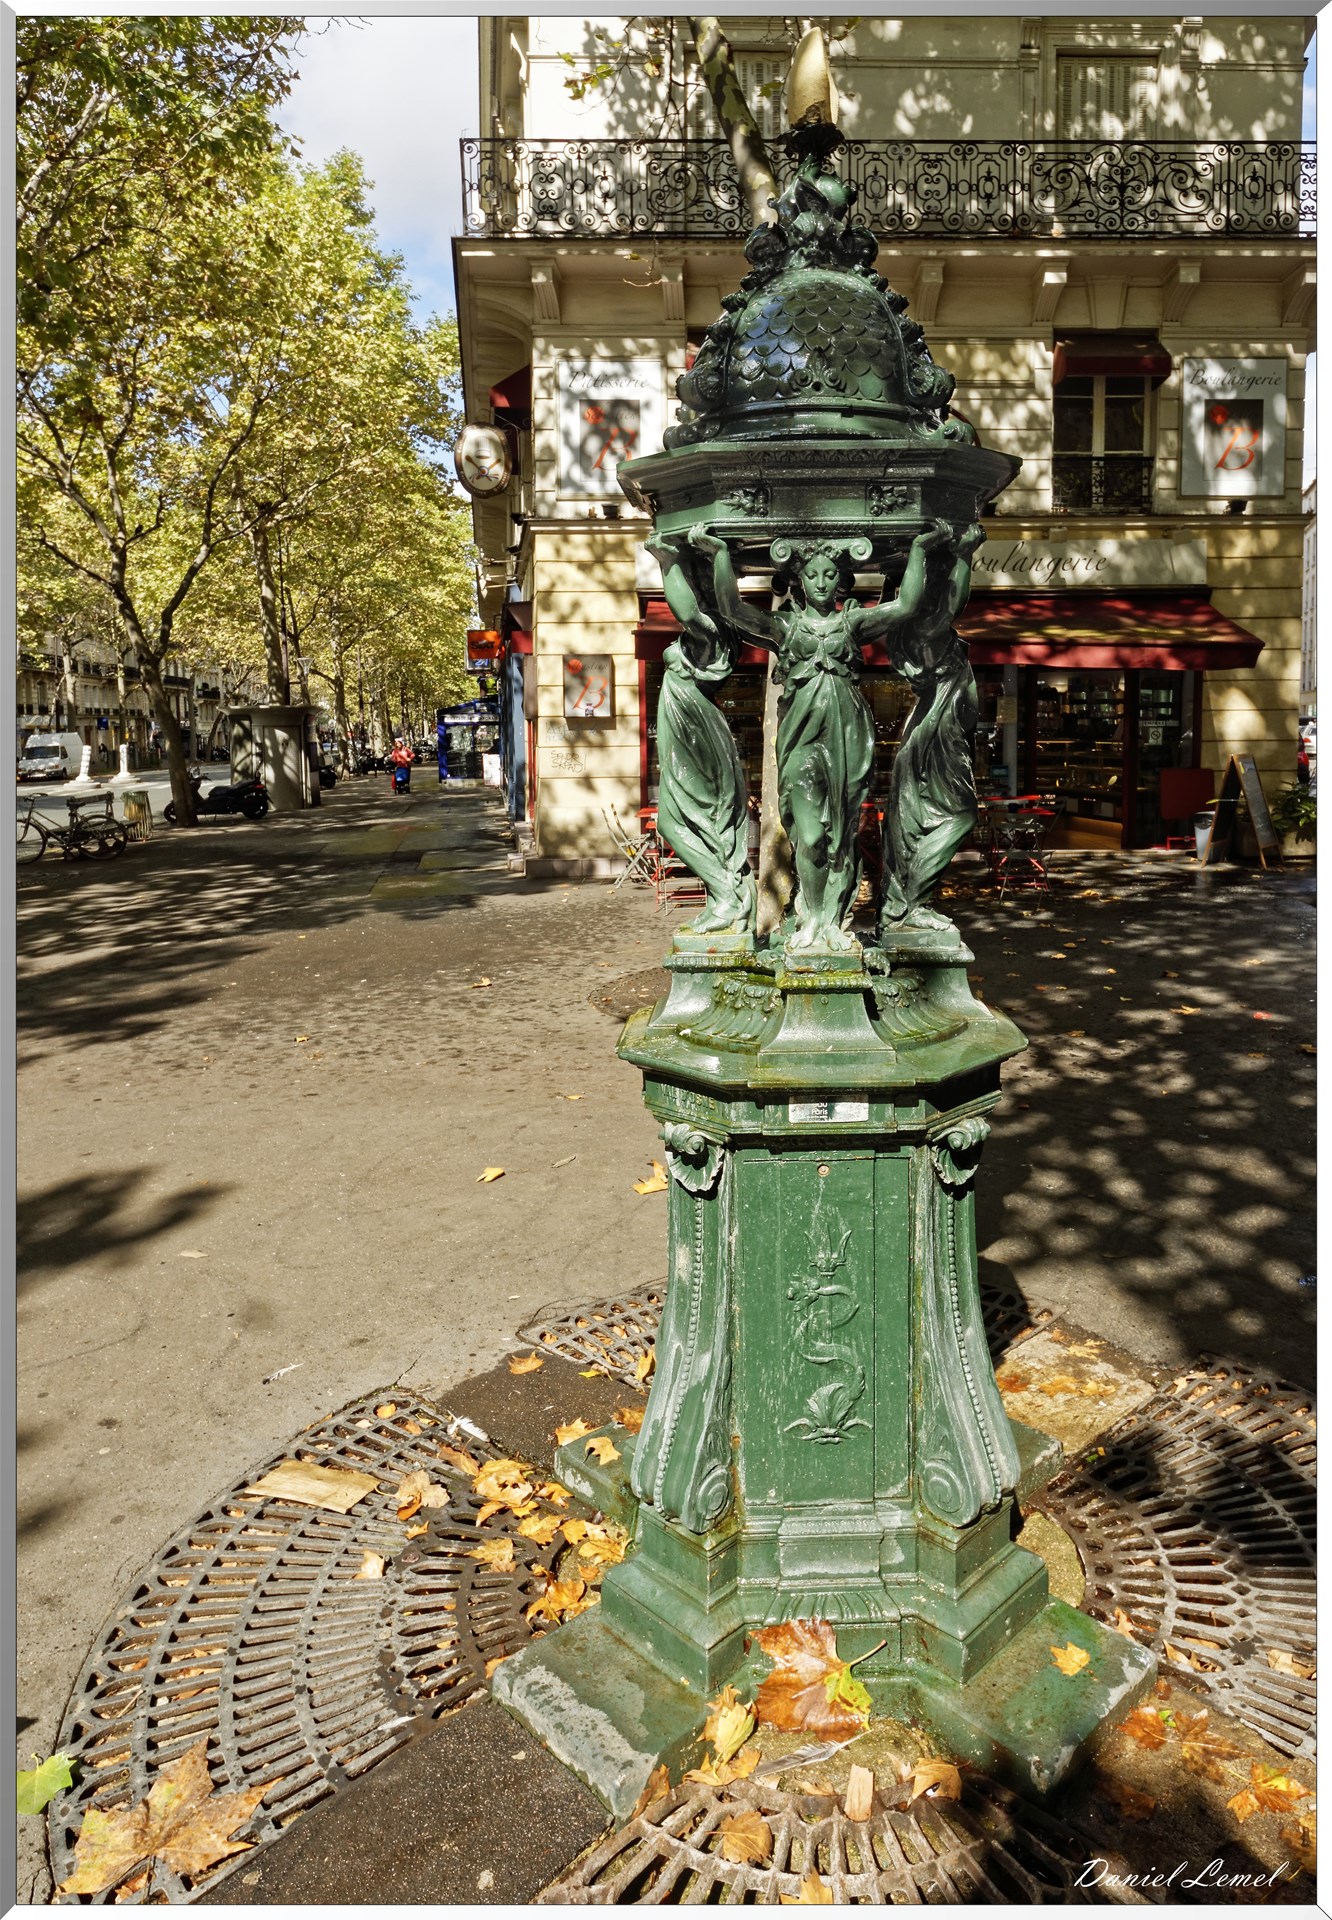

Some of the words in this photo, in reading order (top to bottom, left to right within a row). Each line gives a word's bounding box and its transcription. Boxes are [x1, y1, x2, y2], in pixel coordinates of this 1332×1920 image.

[1190, 367, 1283, 392] Boulangerie
[1215, 427, 1260, 471] B
[972, 541, 1112, 584] oulangerie
